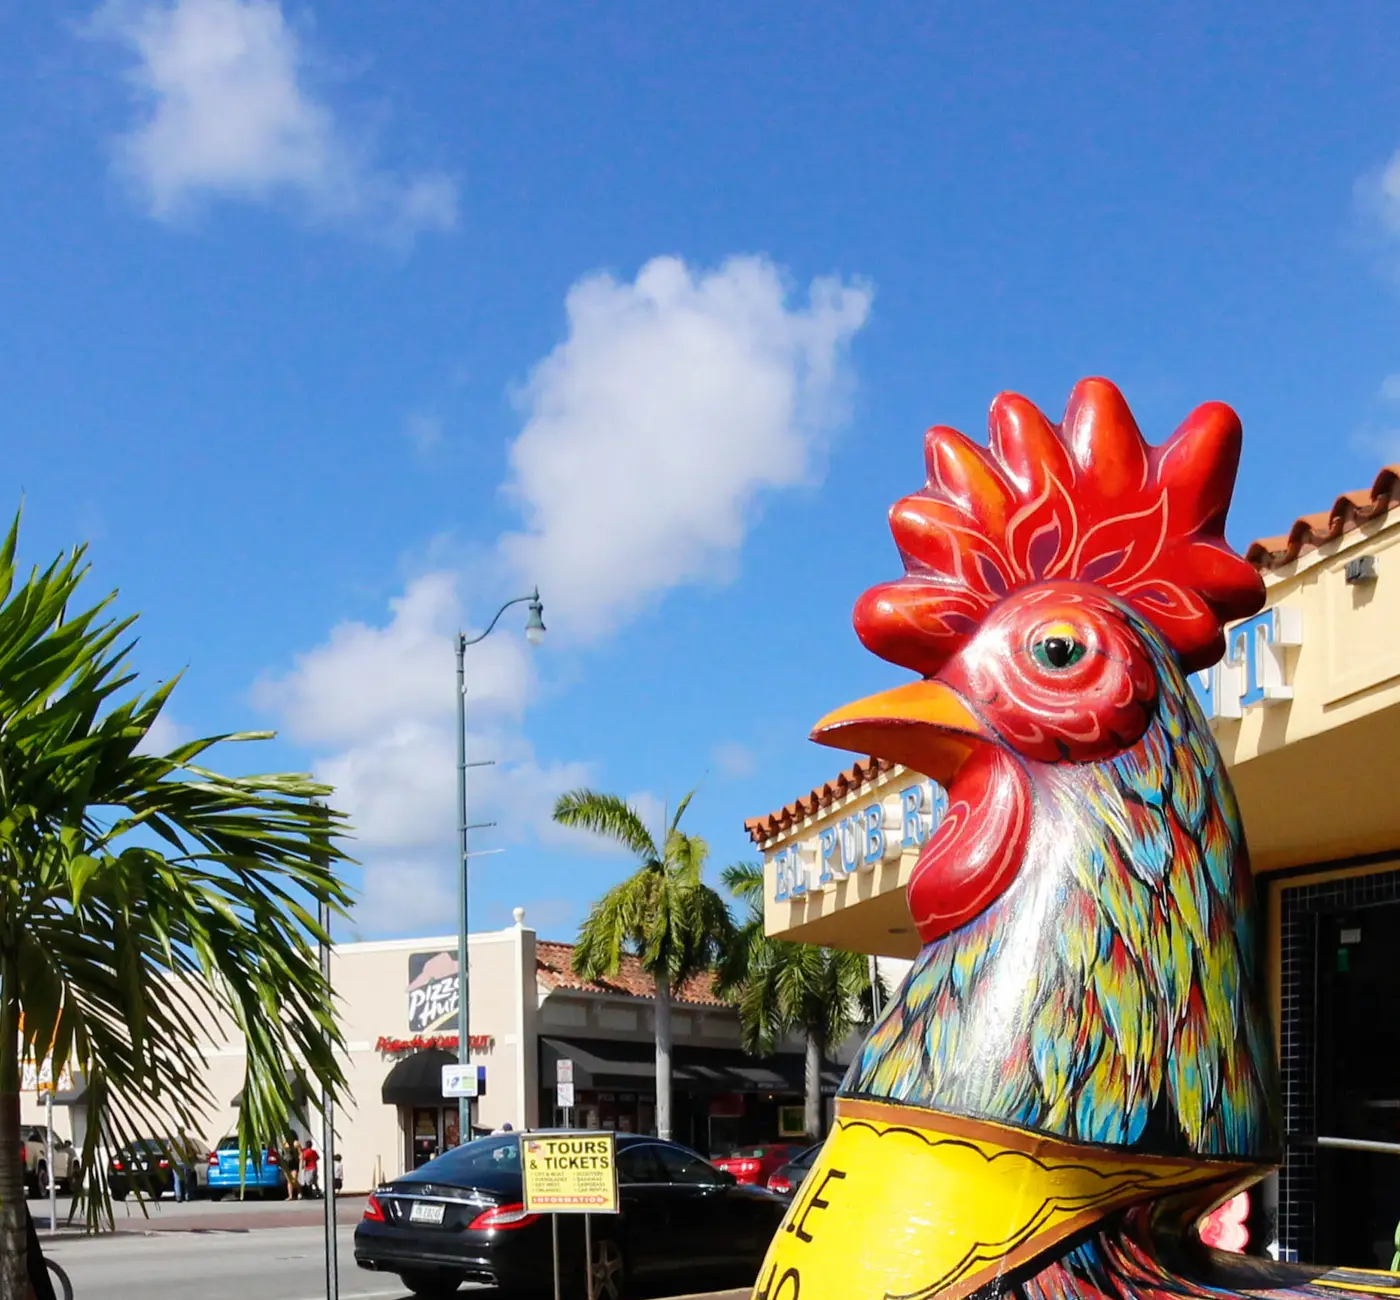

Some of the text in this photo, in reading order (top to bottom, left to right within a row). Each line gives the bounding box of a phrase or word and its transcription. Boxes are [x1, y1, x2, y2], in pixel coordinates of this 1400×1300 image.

[775, 842, 808, 902] EL
[819, 803, 885, 883] PUB
[546, 1141, 608, 1154] TOURS
[529, 1156, 609, 1169] & TICKETS
